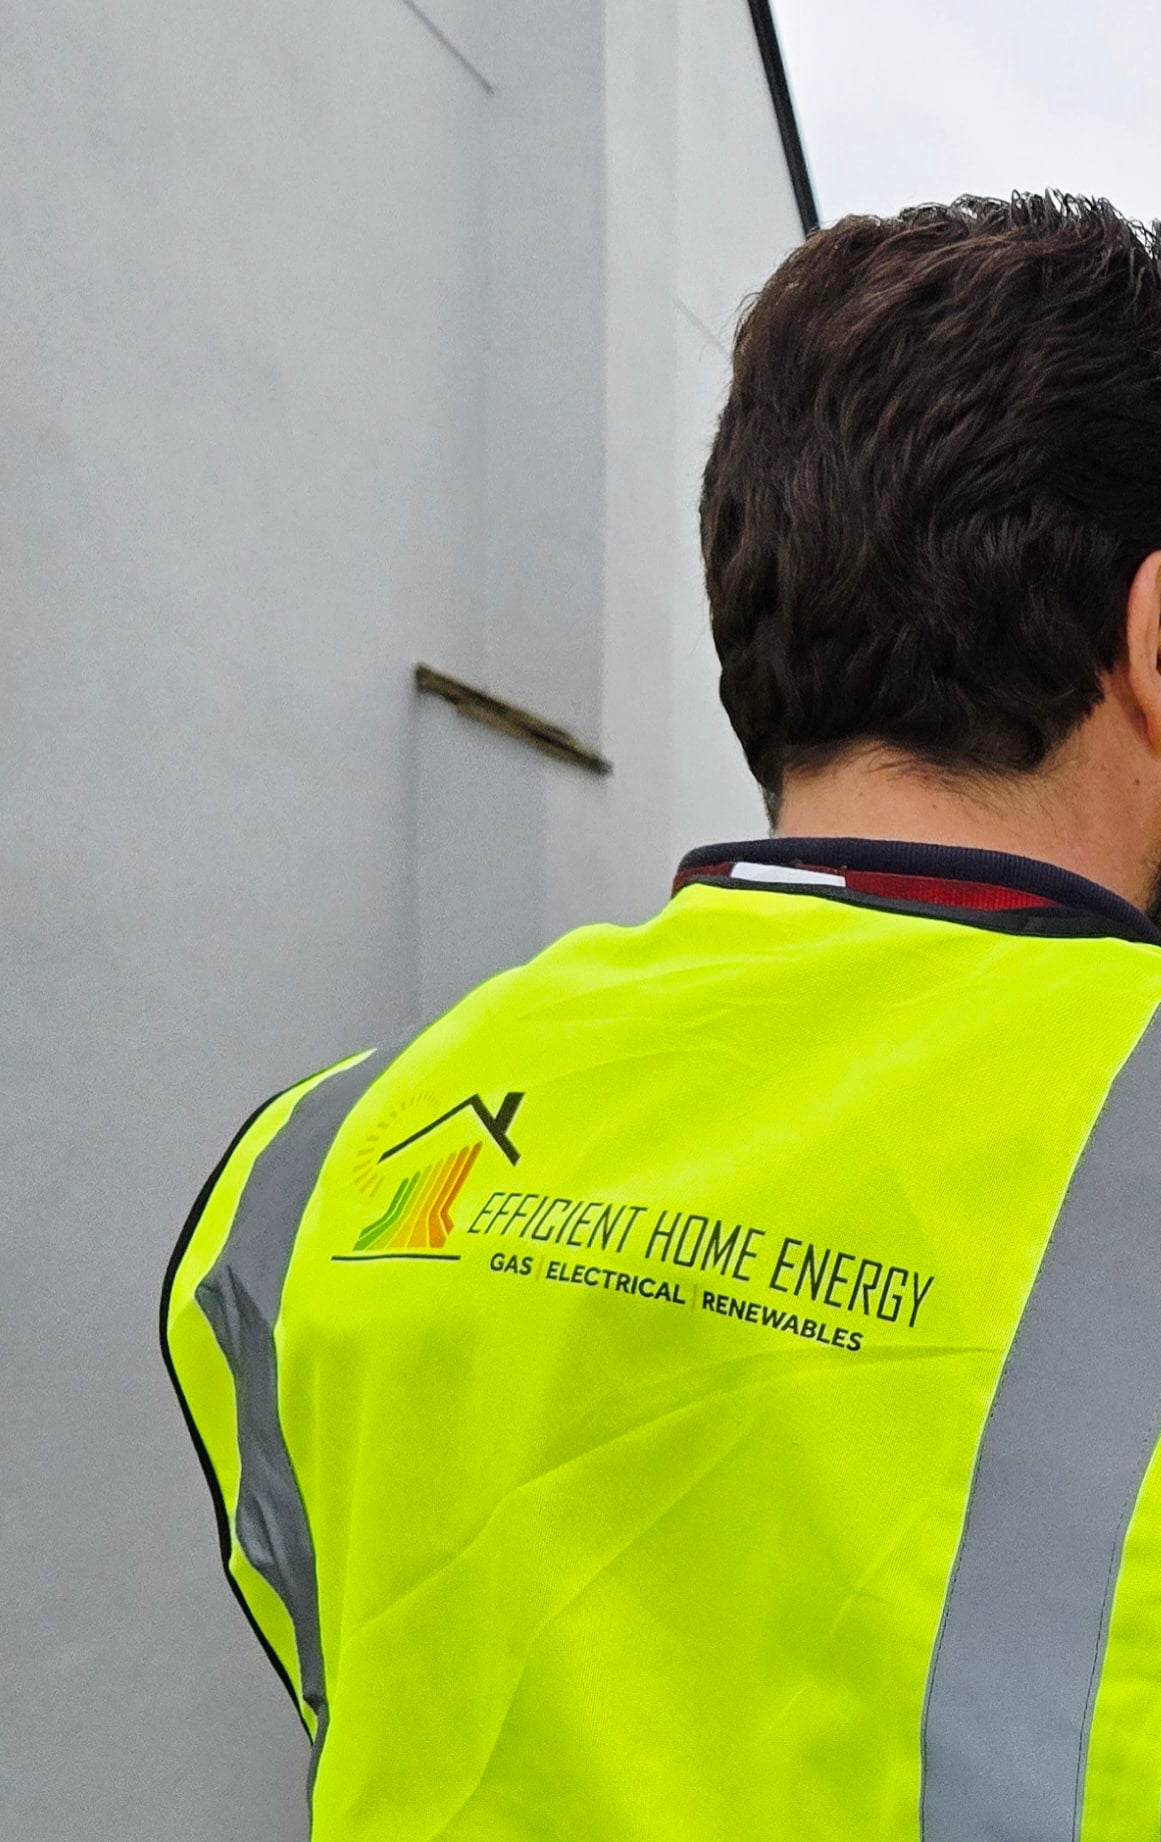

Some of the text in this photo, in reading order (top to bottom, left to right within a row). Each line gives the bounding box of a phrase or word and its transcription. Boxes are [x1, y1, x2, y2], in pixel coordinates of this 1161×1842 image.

[468, 1191, 934, 1328] EFFICIENT HOME ENERGY
[490, 1253, 864, 1353] GAS ELECTRICAL RENEWABLES
